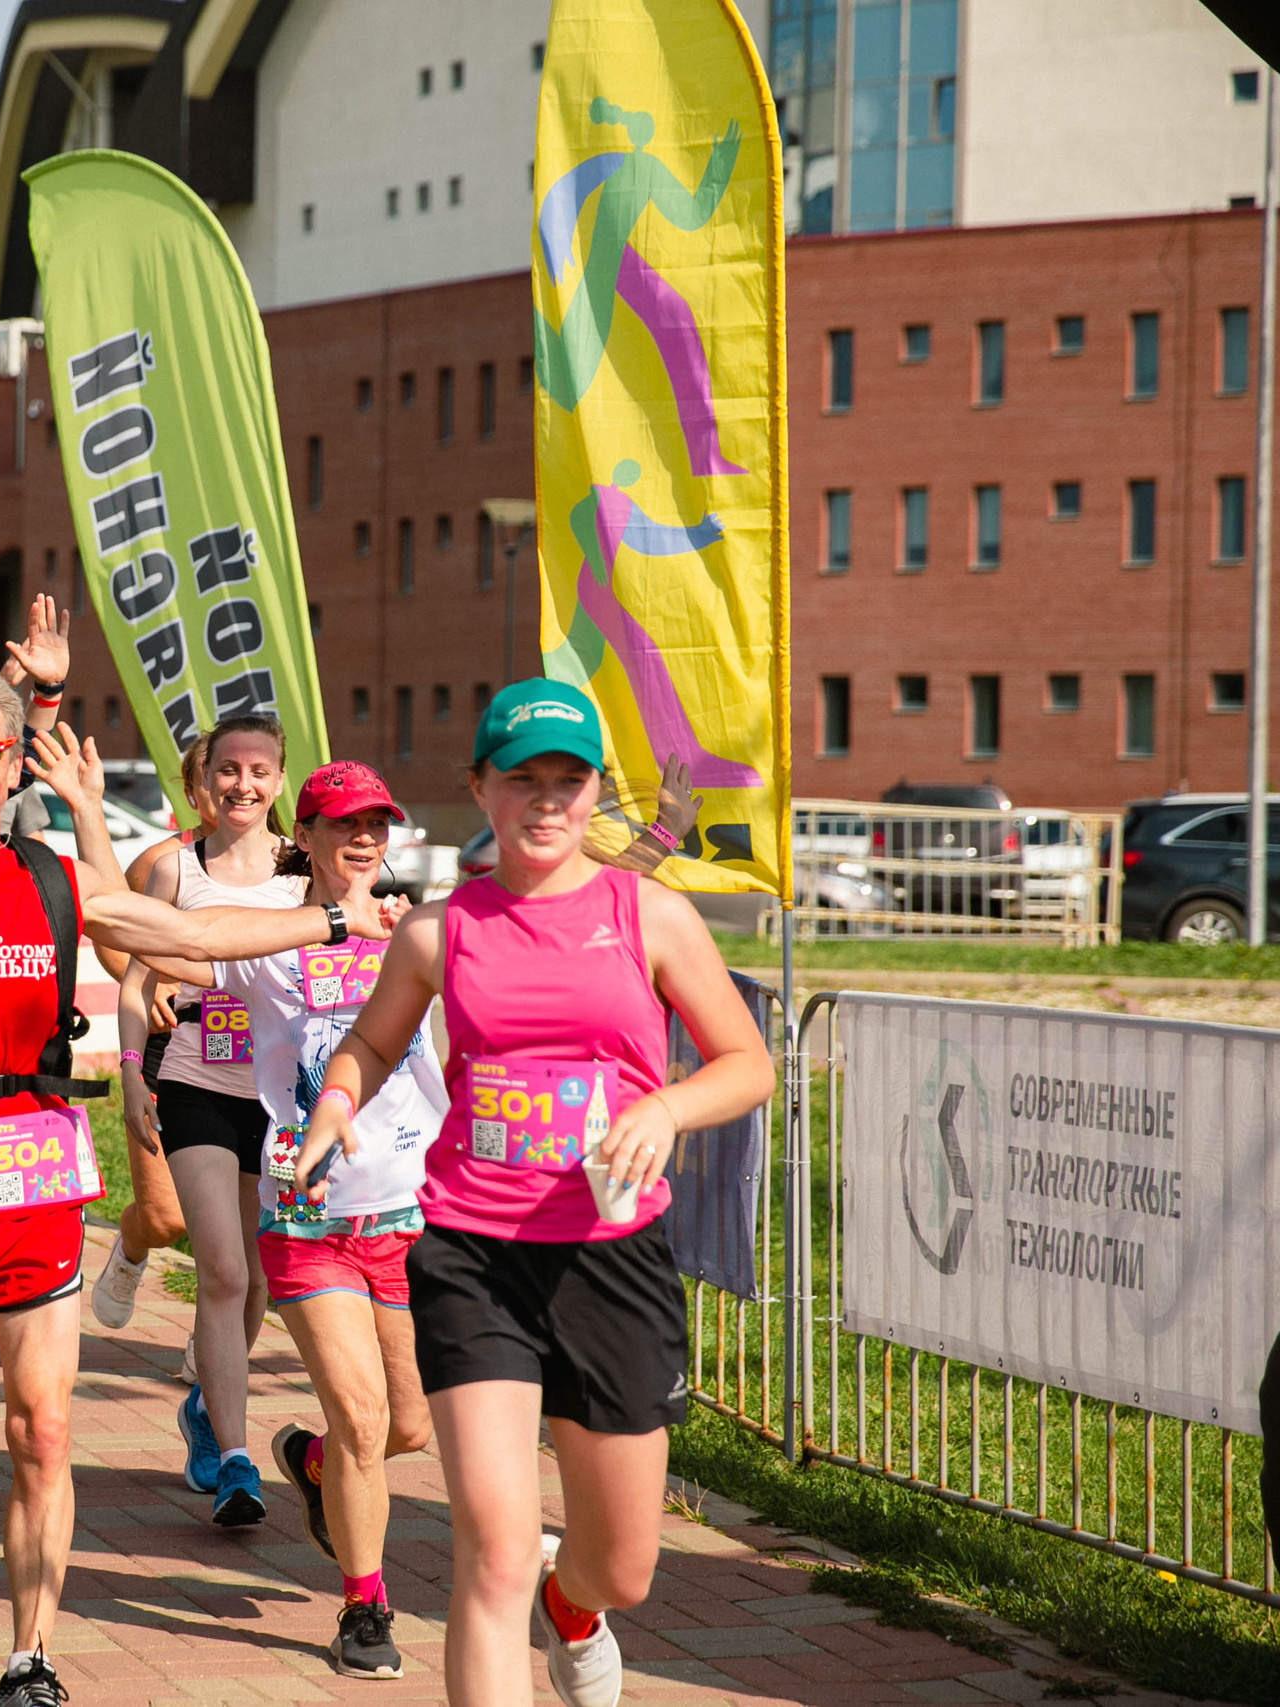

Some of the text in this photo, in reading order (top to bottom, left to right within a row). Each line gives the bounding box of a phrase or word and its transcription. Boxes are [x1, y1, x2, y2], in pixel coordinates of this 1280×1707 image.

[307, 954, 381, 977] 074
[206, 994, 230, 1002] RUTS
[472, 1086, 554, 1125] 301
[568, 1081, 579, 1095] 1
[1009, 1072, 1176, 1140] СОВРЕМЕННЫЕ
[1007, 1145, 1183, 1219] ТРАНСПОРТНЫЕ
[1006, 1218, 1144, 1291] ТЕХНОЛОГИИ
